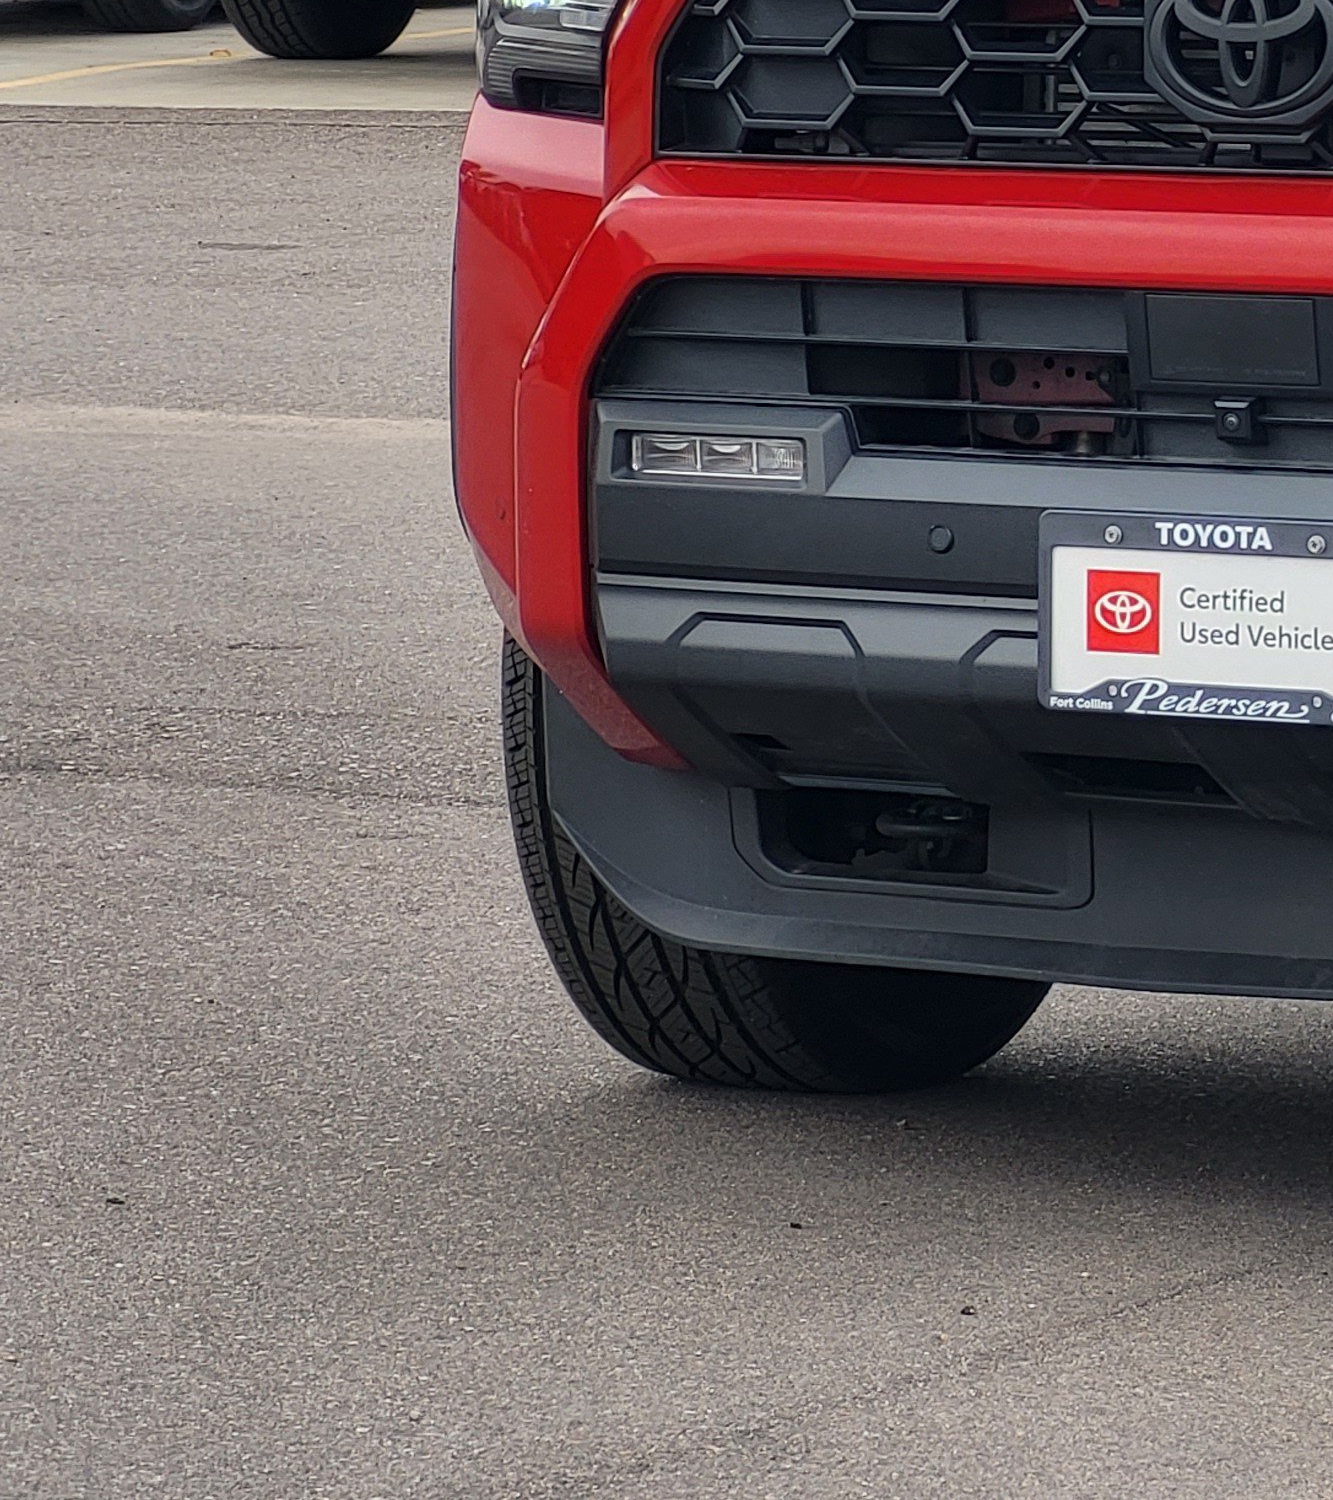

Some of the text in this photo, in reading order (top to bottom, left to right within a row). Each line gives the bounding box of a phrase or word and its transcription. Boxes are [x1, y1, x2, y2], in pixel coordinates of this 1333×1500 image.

[1155, 522, 1273, 551] TOYOTA
[1179, 586, 1285, 614] Certified
[1179, 621, 1240, 647] Used
[1050, 696, 1114, 711] Fort Collins
[1121, 678, 1311, 723] Pedersen
